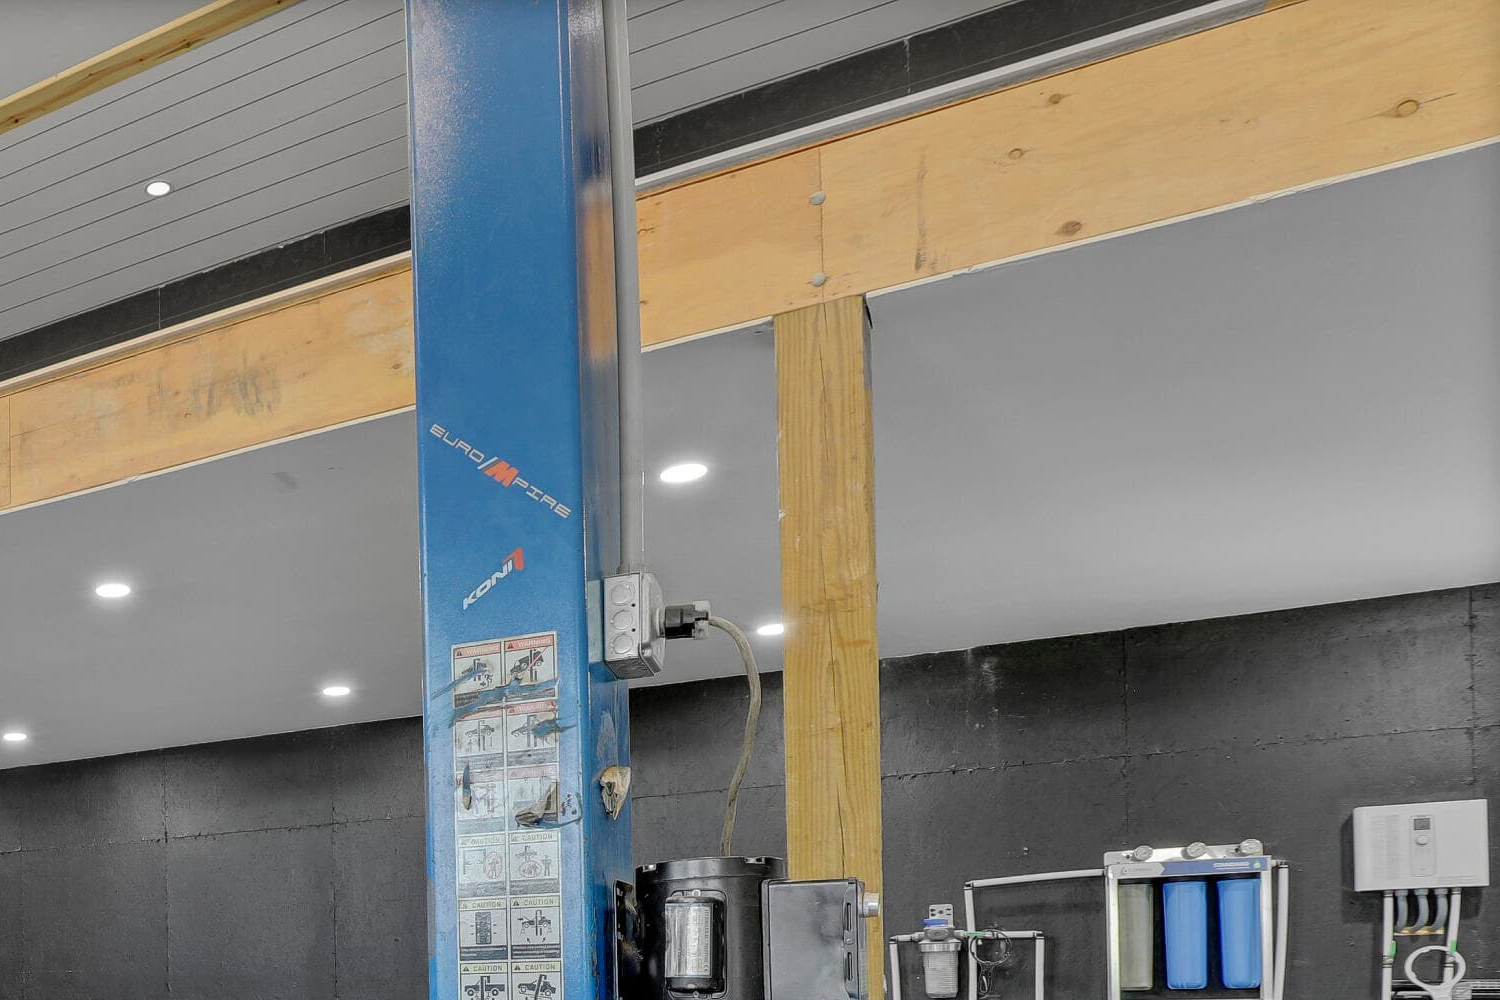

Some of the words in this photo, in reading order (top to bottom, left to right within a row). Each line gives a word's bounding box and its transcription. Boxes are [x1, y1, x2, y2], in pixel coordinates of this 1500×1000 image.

[522, 834, 553, 842] CAUTION
[471, 901, 502, 909] CAUTION
[524, 963, 556, 971] CAUTION
